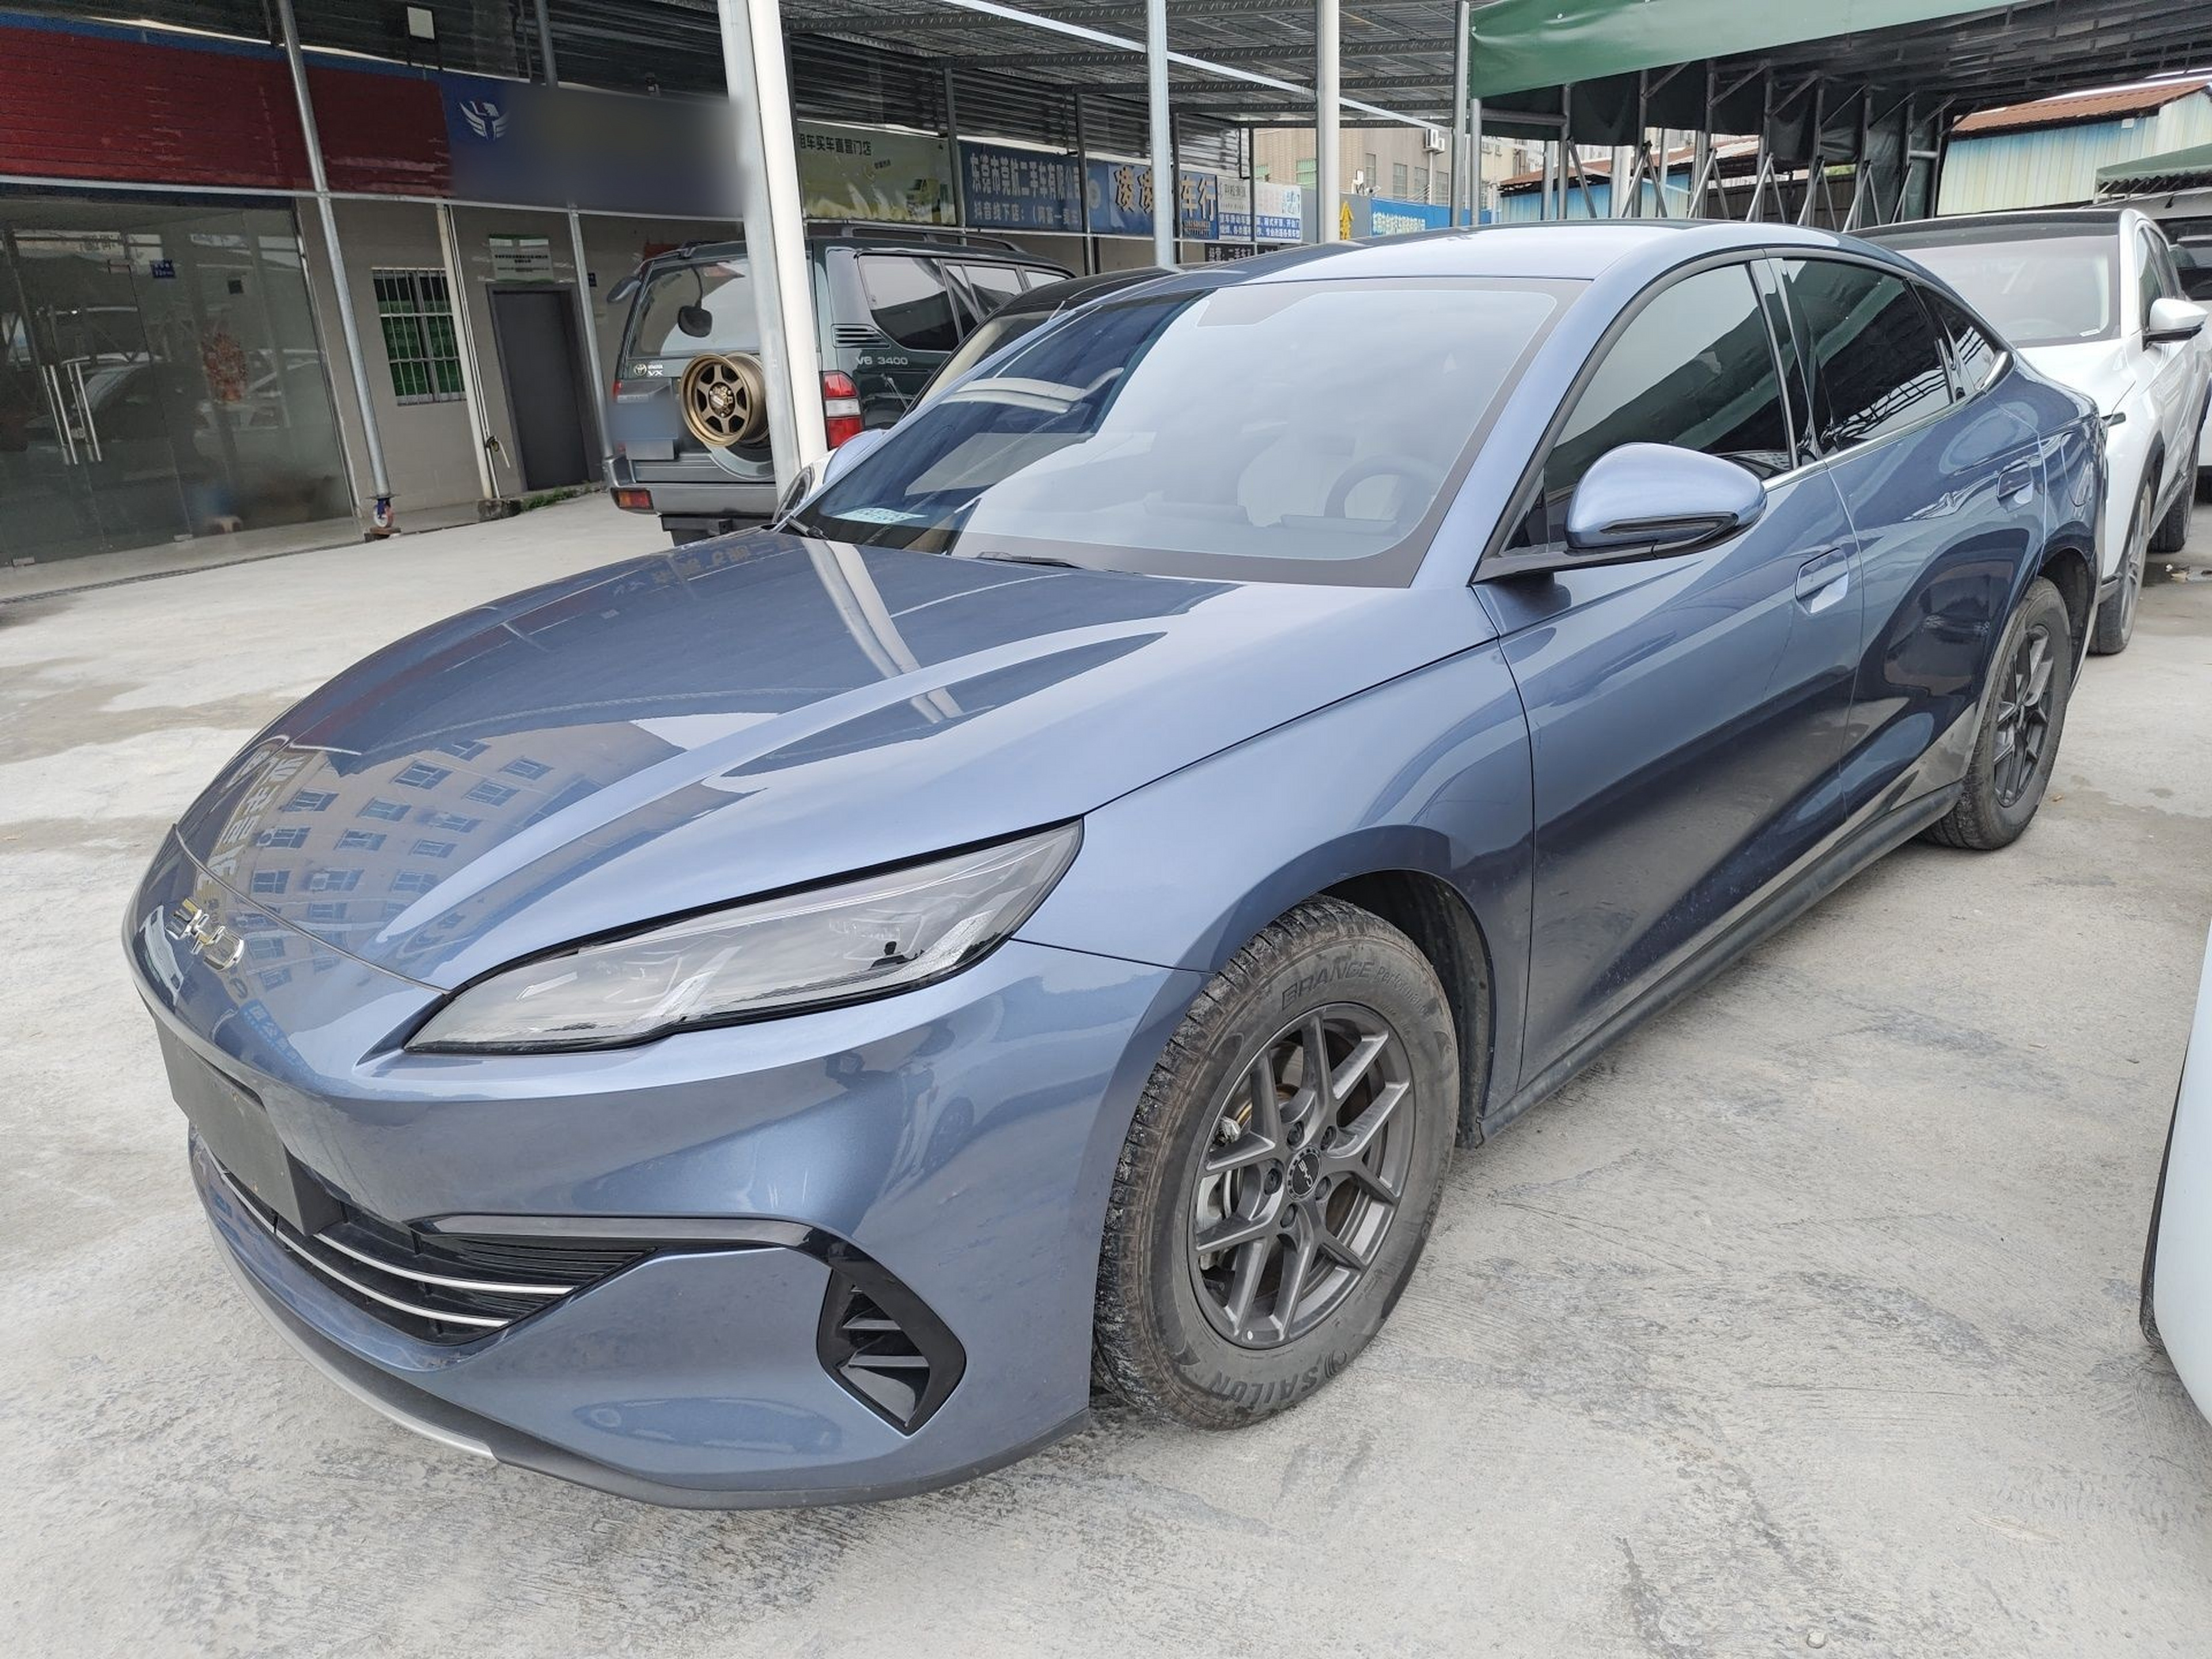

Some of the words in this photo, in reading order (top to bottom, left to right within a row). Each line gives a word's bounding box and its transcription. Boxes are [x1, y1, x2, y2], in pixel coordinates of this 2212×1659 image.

[856, 357, 873, 365] V6
[877, 357, 908, 365] 3400
[1298, 1159, 1313, 1188] BYD
[1210, 1366, 1319, 1410] SAILUN
